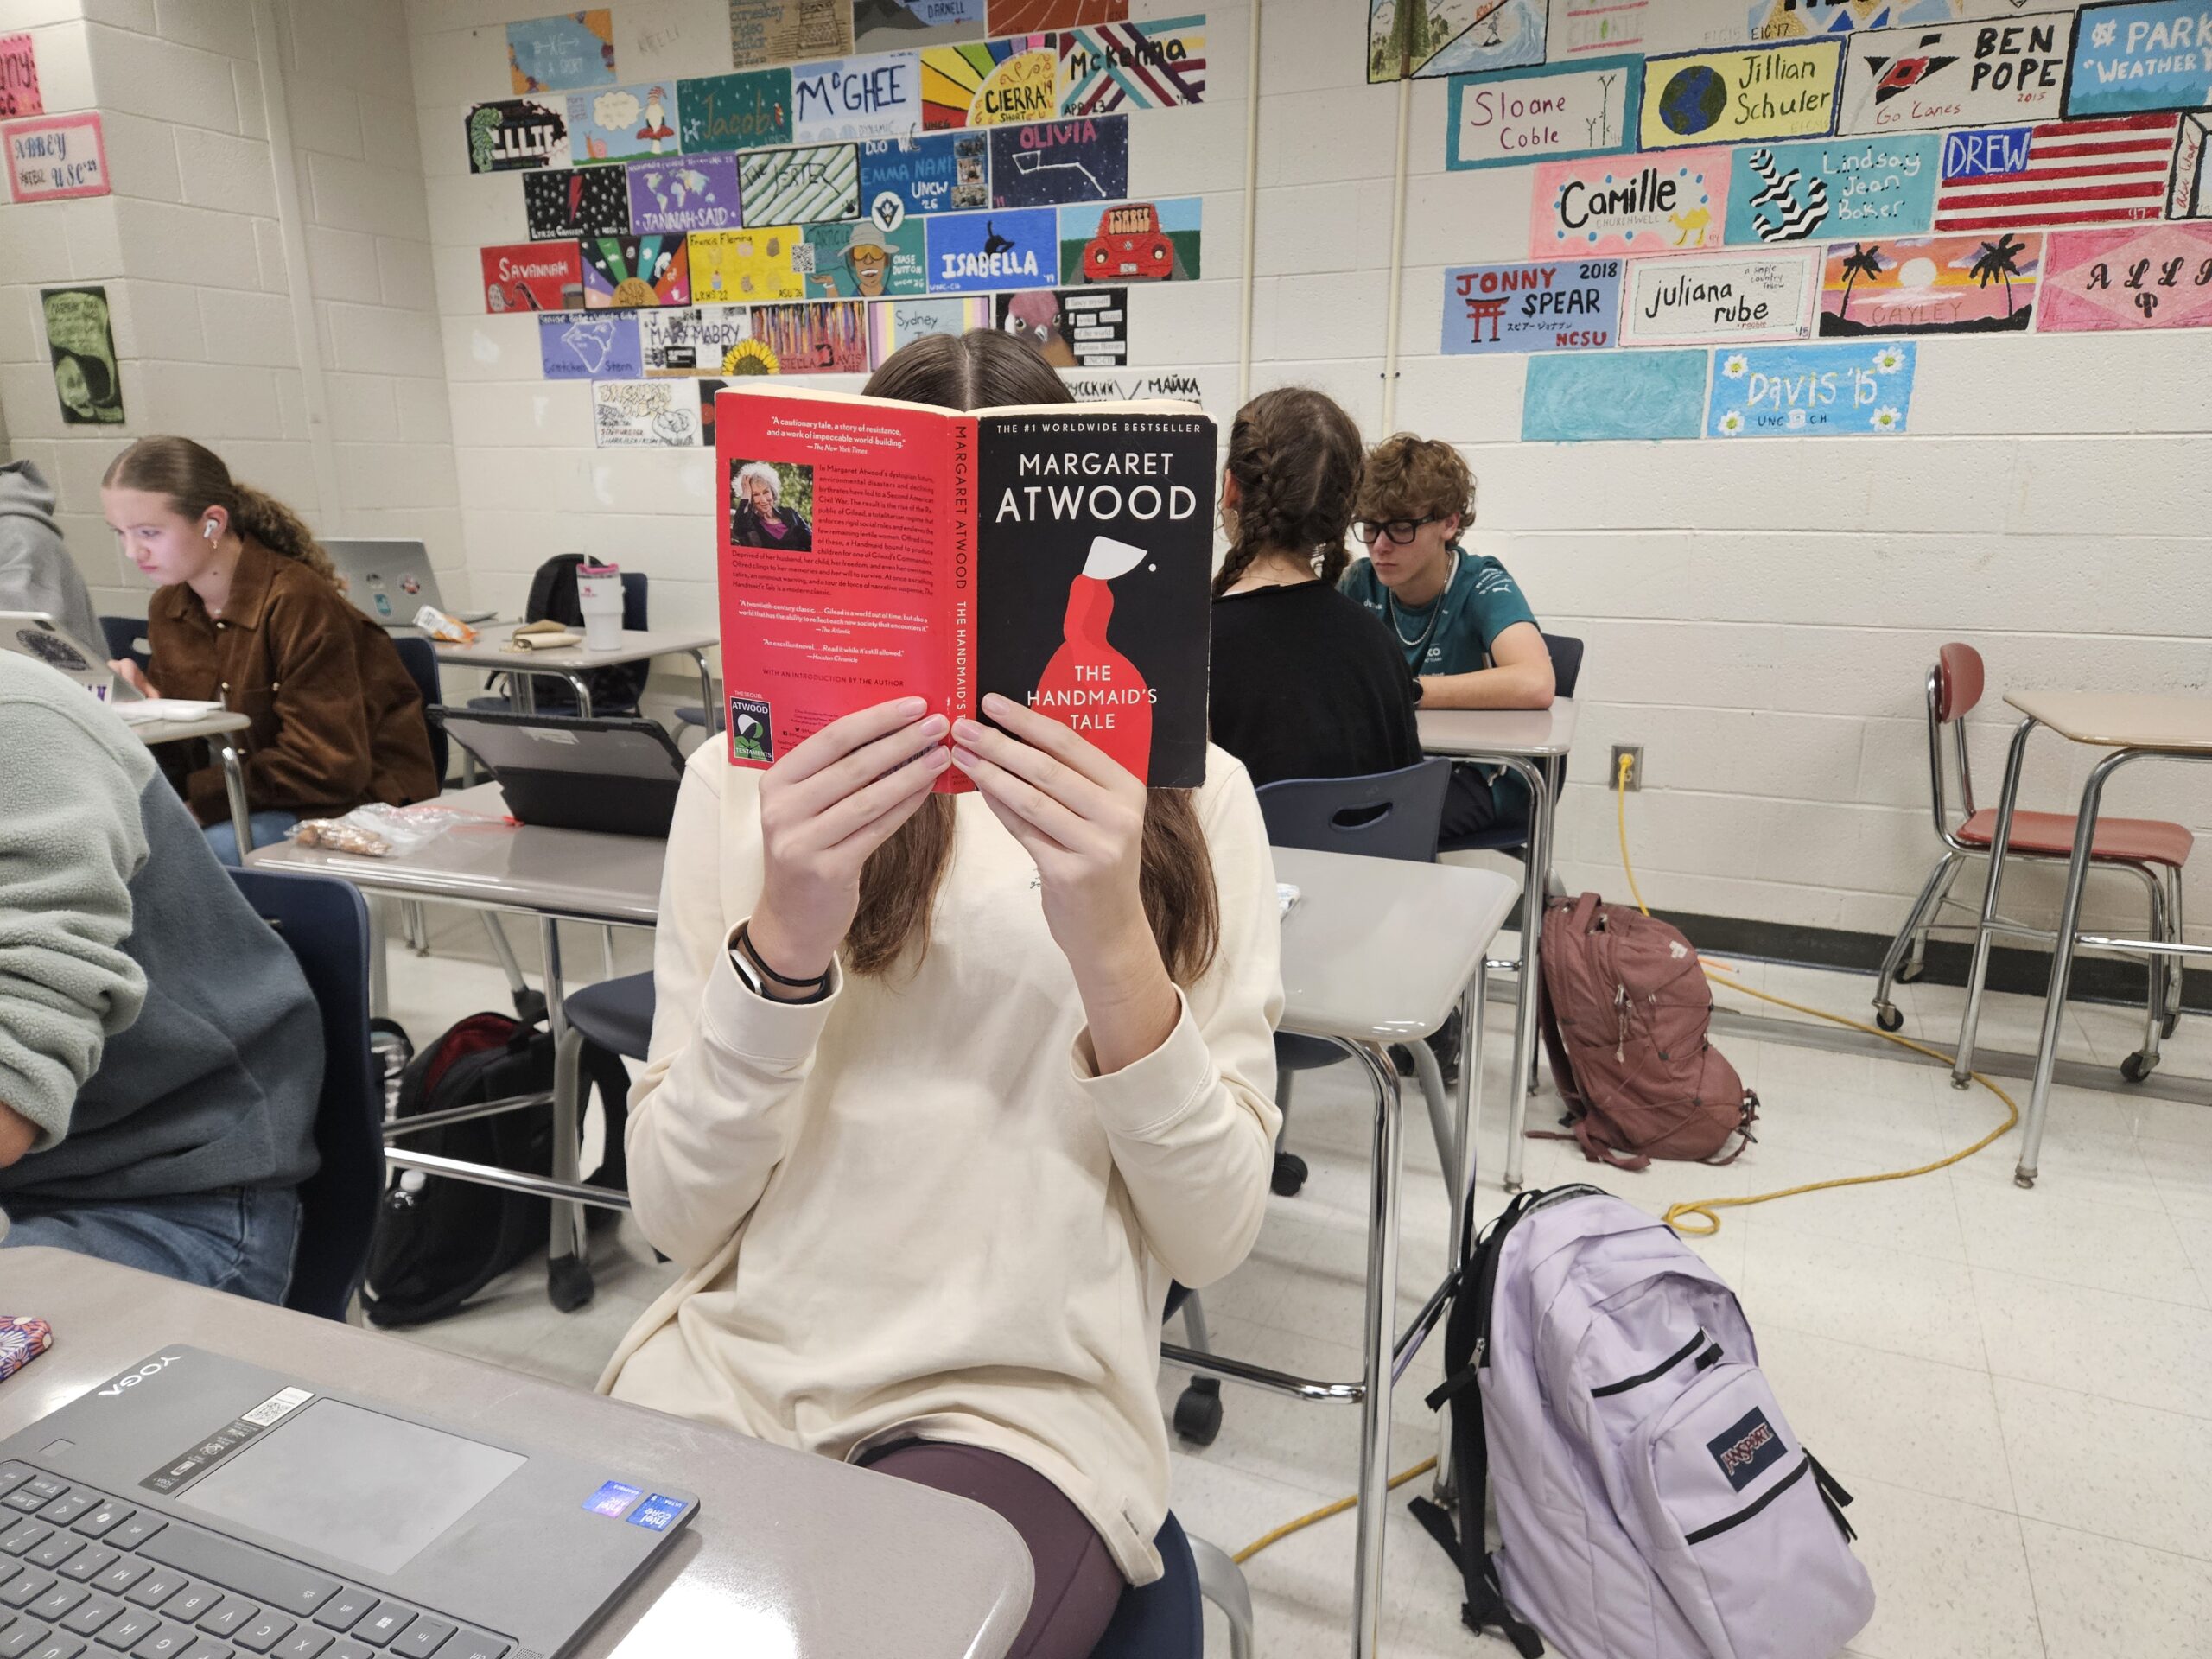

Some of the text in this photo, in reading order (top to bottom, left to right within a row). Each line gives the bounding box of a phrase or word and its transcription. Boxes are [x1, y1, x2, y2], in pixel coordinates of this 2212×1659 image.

[927, 2, 965, 19] DARNELL
[1751, 26, 1771, 41] EIC
[1974, 25, 2055, 60] BEN
[1738, 54, 1816, 88] Jillian
[1970, 58, 2063, 92] POPE
[985, 84, 1048, 114] CIERRA
[1471, 91, 1566, 127] Sloane
[1734, 89, 1832, 126] Schuler
[2017, 92, 2047, 103] 2015
[702, 89, 772, 139] Jacob
[999, 111, 1027, 124] SHORT
[1876, 106, 1902, 125] Go
[1019, 118, 1097, 149] OLIVIA
[1500, 127, 1560, 150] Coble
[15, 133, 67, 162] ABBEY
[865, 140, 889, 156] DUO
[1946, 131, 2031, 178] DREW
[1822, 145, 1922, 176] Lindsay
[51, 163, 85, 188] USC
[1842, 175, 1900, 197] Jean
[911, 180, 950, 199] UNCW
[1560, 168, 1677, 229] Camille
[1838, 199, 1906, 220] Baker
[1108, 207, 1152, 236] ISABEL
[1596, 213, 1660, 230] CHURCHWELL
[690, 232, 753, 248] Francis Fleming
[499, 257, 569, 283] SAVANNAH
[892, 265, 923, 277] DUTTON
[941, 250, 1039, 280] ISABELLA
[1753, 265, 1777, 275] simple
[1455, 262, 1618, 296] JONNY 2018
[1750, 274, 1783, 283] country
[1521, 289, 1601, 319] SPEAR
[1644, 274, 1732, 319] juliana
[895, 309, 939, 329] Sydney
[1713, 295, 1769, 324] rube
[1872, 302, 1963, 325] CAYLEY
[692, 323, 741, 346] MABRY
[1555, 331, 1608, 347] NCSU
[1848, 366, 1879, 409] '15
[780, 419, 817, 430] cautionary
[818, 421, 834, 430] tale,
[839, 423, 857, 433] story
[858, 423, 866, 432] of
[866, 426, 902, 436] resistance,
[997, 423, 1201, 433] THE #1 WORLDWIDE BESTSELLER
[1757, 414, 1828, 428] UNC CH
[785, 430, 804, 439] work
[804, 430, 812, 439] of
[812, 432, 853, 444] impeccable
[824, 443, 837, 452] New
[839, 444, 851, 453] York
[852, 446, 868, 454] Times
[954, 425, 968, 515] MARGARET
[1020, 452, 1174, 476] MARGARET
[995, 485, 1197, 523] ATWOOD
[955, 520, 968, 590] ATWOOD
[956, 601, 968, 626] THE
[791, 671, 847, 683] INTRODUCTION
[874, 677, 905, 687] AUTHOR
[956, 629, 968, 711] HANDMAID'S
[1075, 665, 1112, 682] THE
[732, 701, 769, 715] ATWOOD
[1027, 689, 1159, 706] HANDMAID'S
[1071, 714, 1116, 730] TALE
[735, 747, 772, 759] TESTAMENTS
[98, 1354, 181, 1398] YOGA
[639, 1515, 668, 1529] intel
